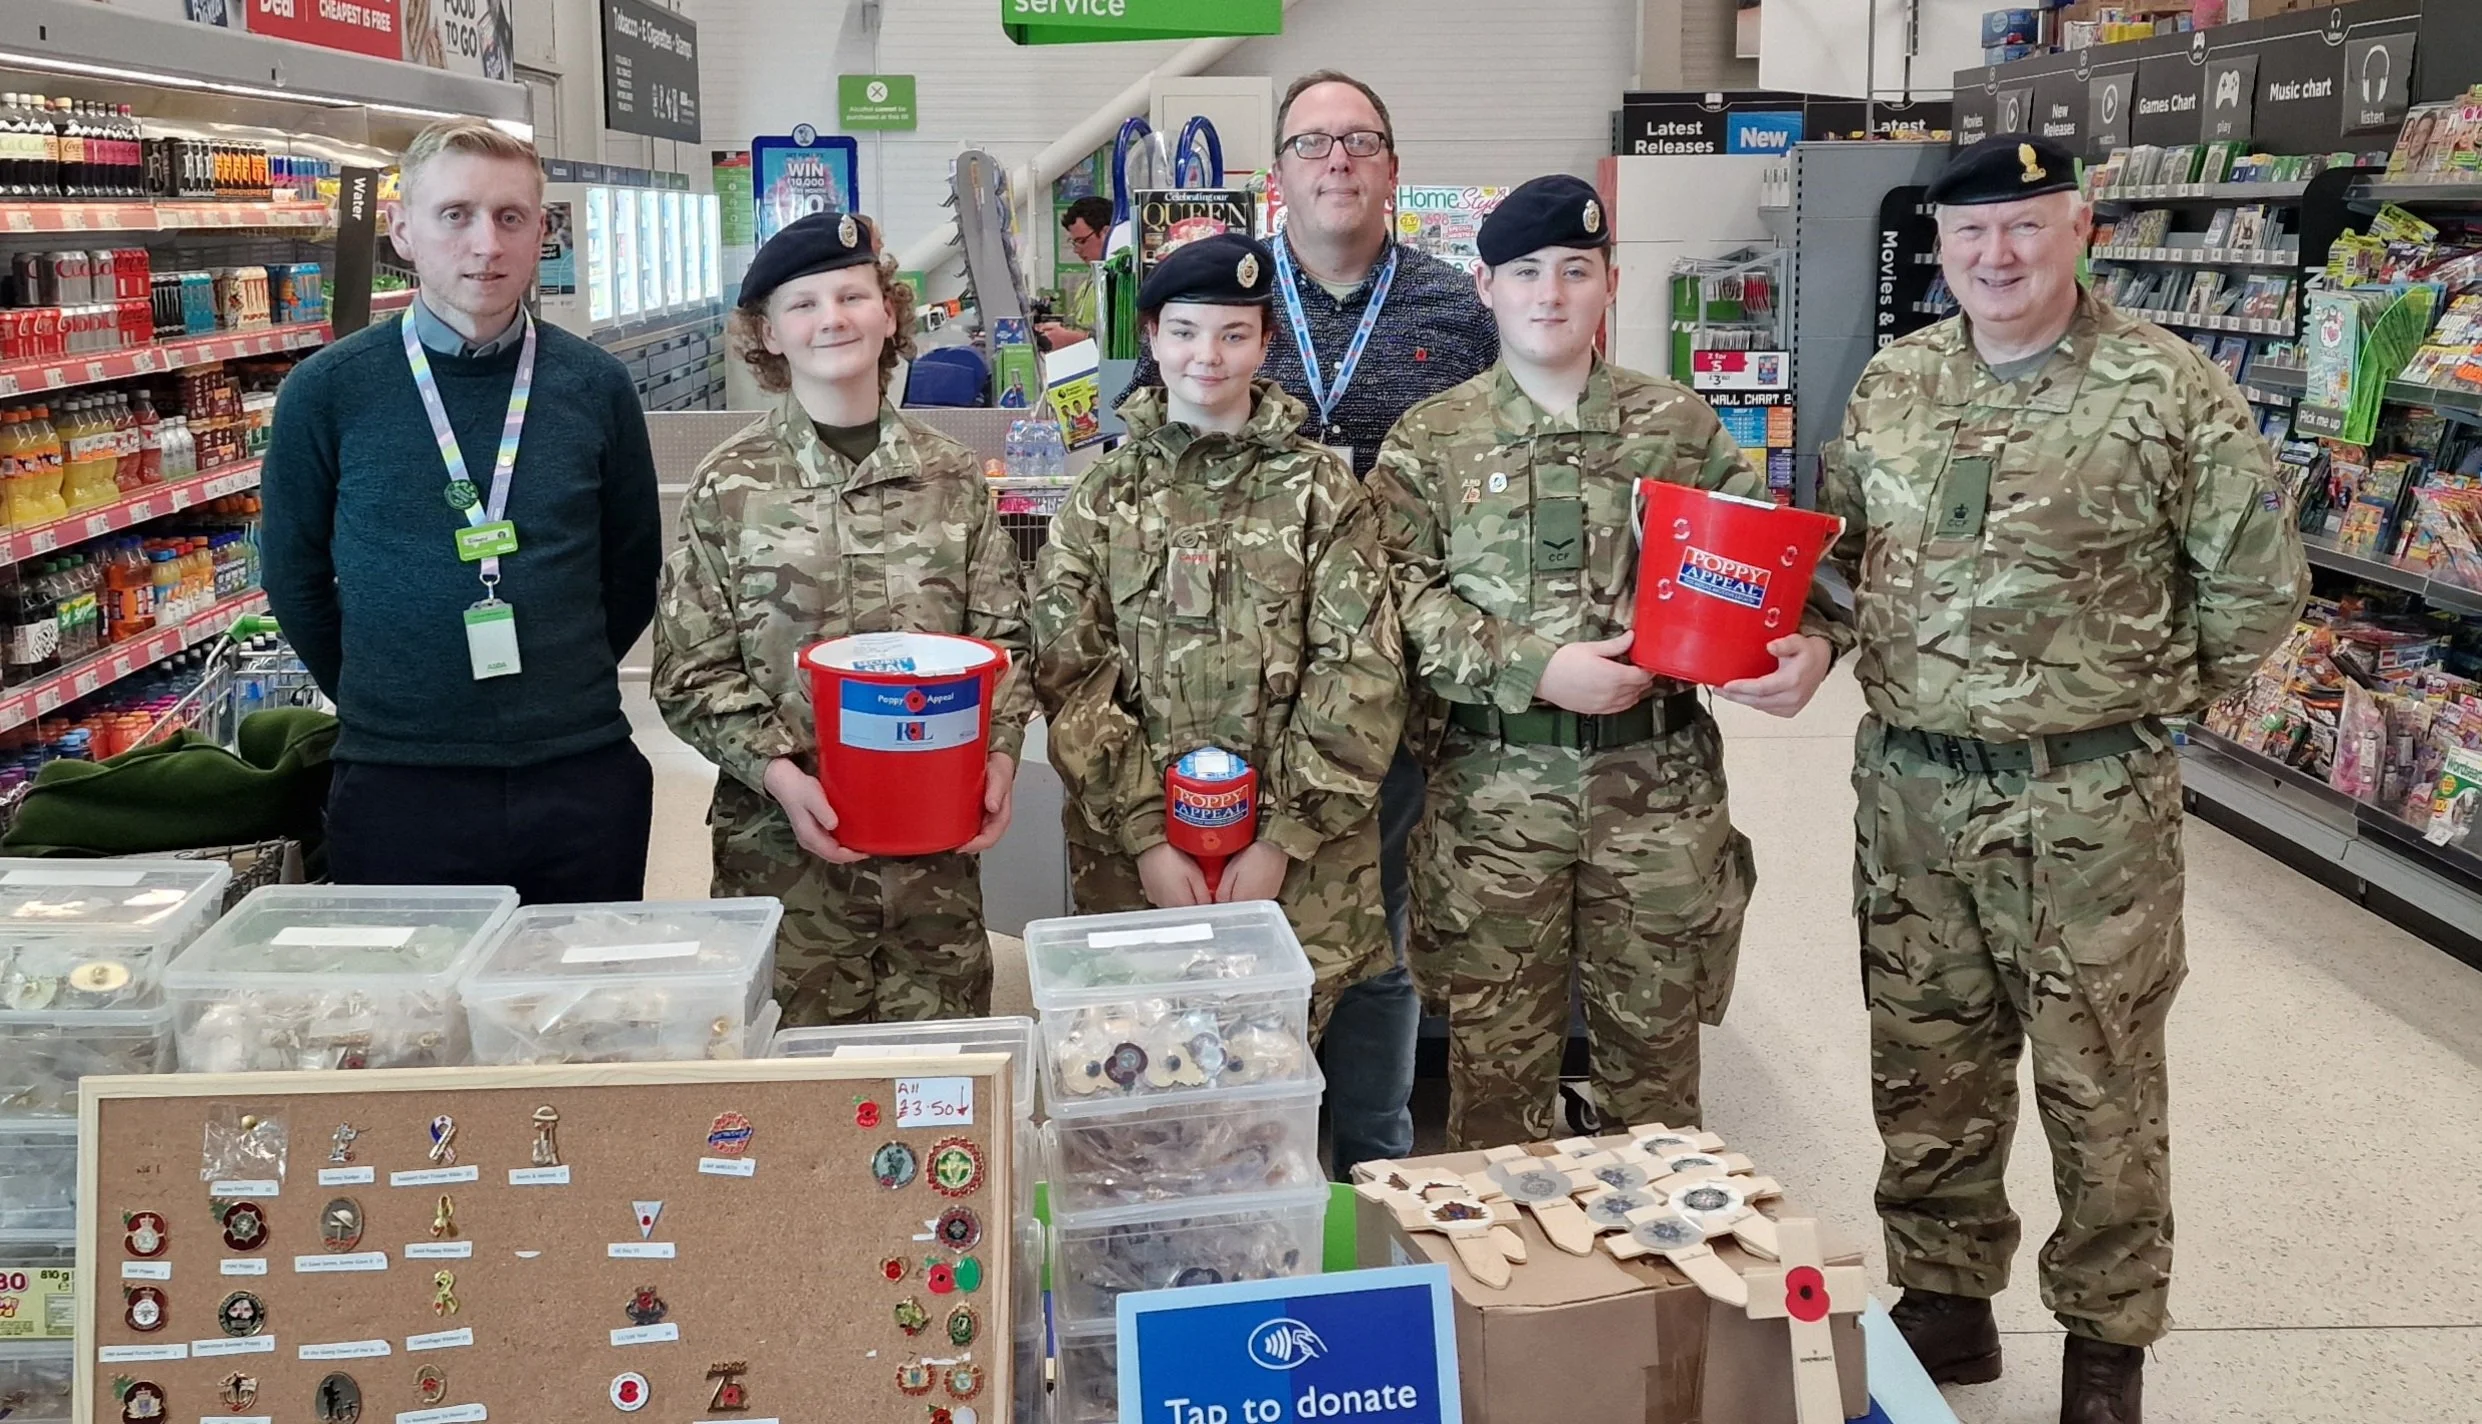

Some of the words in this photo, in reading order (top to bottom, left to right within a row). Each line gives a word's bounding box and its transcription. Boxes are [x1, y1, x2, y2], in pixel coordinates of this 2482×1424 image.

[319, 0, 361, 25] CHEAPEST
[362, 8, 371, 27] IS
[371, 10, 392, 33] FREE
[1014, 0, 1125, 17] service
[612, 6, 638, 39] Tobacco
[445, 21, 459, 47] TO
[460, 30, 477, 58] GO
[2269, 81, 2300, 102] Music
[2302, 77, 2332, 97] chart
[2052, 103, 2069, 120] New
[2139, 97, 2169, 115] Games
[2171, 93, 2197, 112] Chart
[1870, 118, 1926, 133] Latest
[1963, 112, 1984, 129] Movies
[2360, 109, 2385, 125] listen
[1647, 121, 1704, 136] Latest
[2043, 121, 2076, 138] Releases
[2217, 120, 2232, 135] play
[1740, 127, 1789, 149] New
[1634, 139, 1715, 155] Releases
[787, 163, 824, 177] WIN
[352, 176, 367, 222] Water
[1164, 192, 1212, 202] Celebrating
[1400, 186, 1458, 209] Home
[1142, 201, 1249, 233] QUEEN
[1879, 231, 1899, 306] Movies
[1878, 312, 1895, 327] &
[1710, 393, 1740, 405] WALL
[1744, 393, 1779, 405] CHART
[2300, 410, 2315, 425] Pick
[2316, 415, 2330, 427] me
[2330, 417, 2341, 431] up
[1548, 552, 1570, 562] CCF
[1690, 550, 1764, 584] POPPY
[1685, 565, 1759, 597] APPEAL
[878, 694, 904, 706] Poppy
[927, 692, 955, 705] Appeal
[1180, 788, 1244, 809] POPPY
[1178, 803, 1244, 819] APPEAL
[898, 1083, 920, 1095] All
[41, 1270, 60, 1280] 810
[61, 1271, 70, 1282] g
[1163, 1398, 1228, 1424] Tap
[1242, 1398, 1281, 1424] to
[1296, 1384, 1418, 1419] donate
